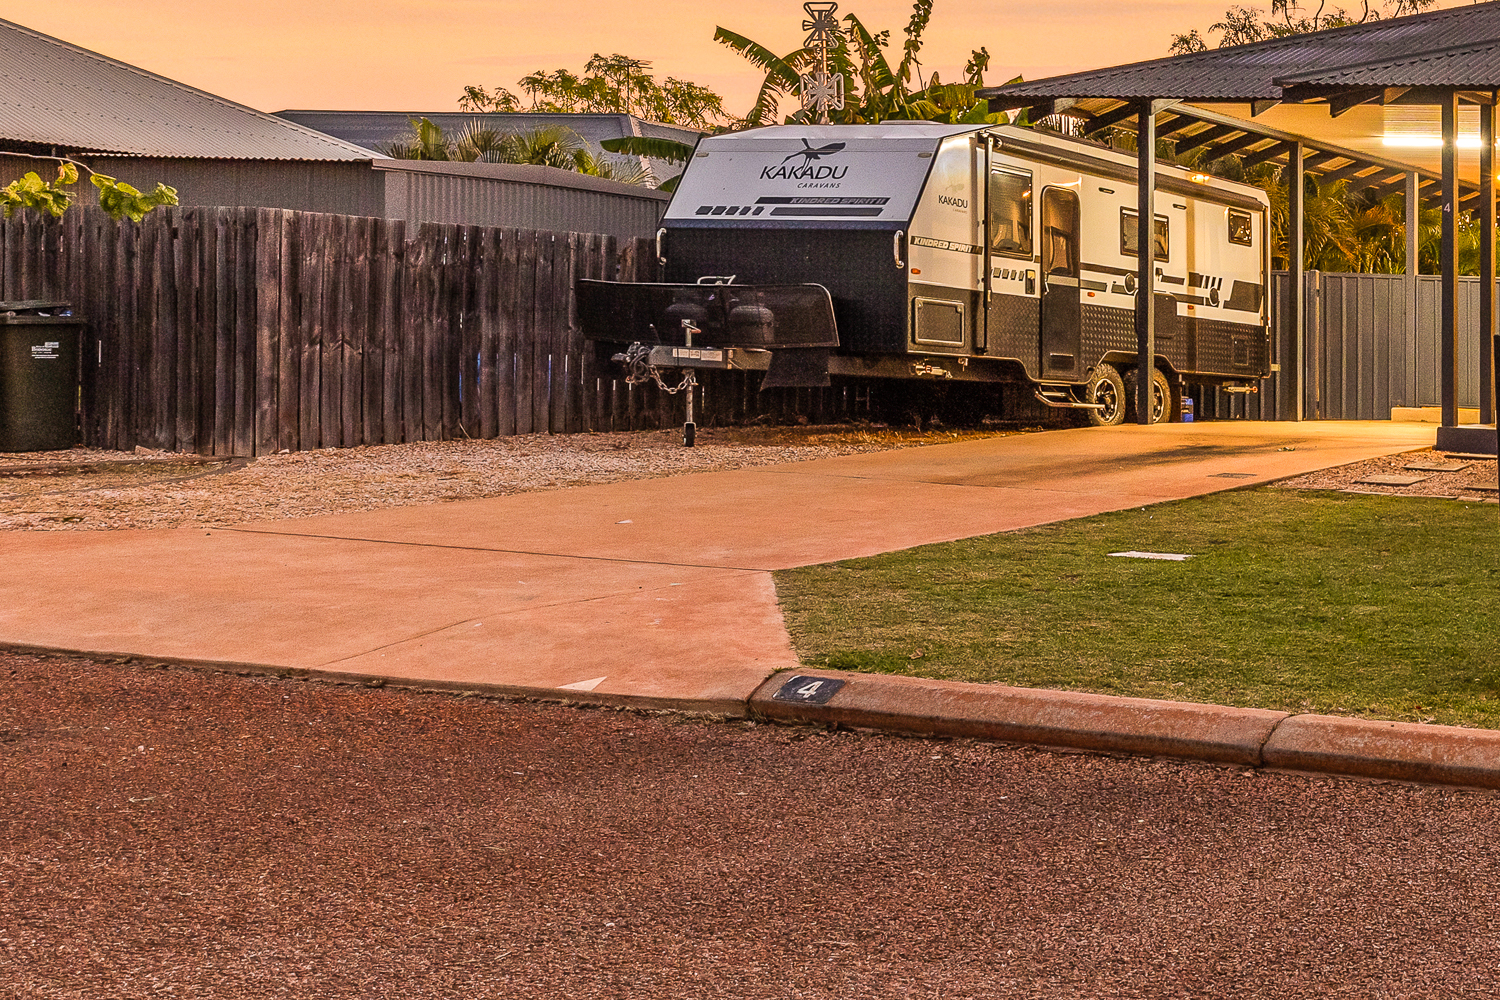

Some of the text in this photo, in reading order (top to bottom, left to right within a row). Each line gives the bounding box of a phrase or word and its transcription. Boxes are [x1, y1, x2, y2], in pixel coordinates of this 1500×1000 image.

[759, 165, 849, 180] KAKADU
[840, 197, 877, 205] SPIRIT
[938, 195, 968, 209] KAKADU
[1443, 202, 1451, 213] 4
[914, 236, 949, 249] KINDRED
[949, 242, 973, 253] SPIRIT
[796, 680, 824, 699] 4
